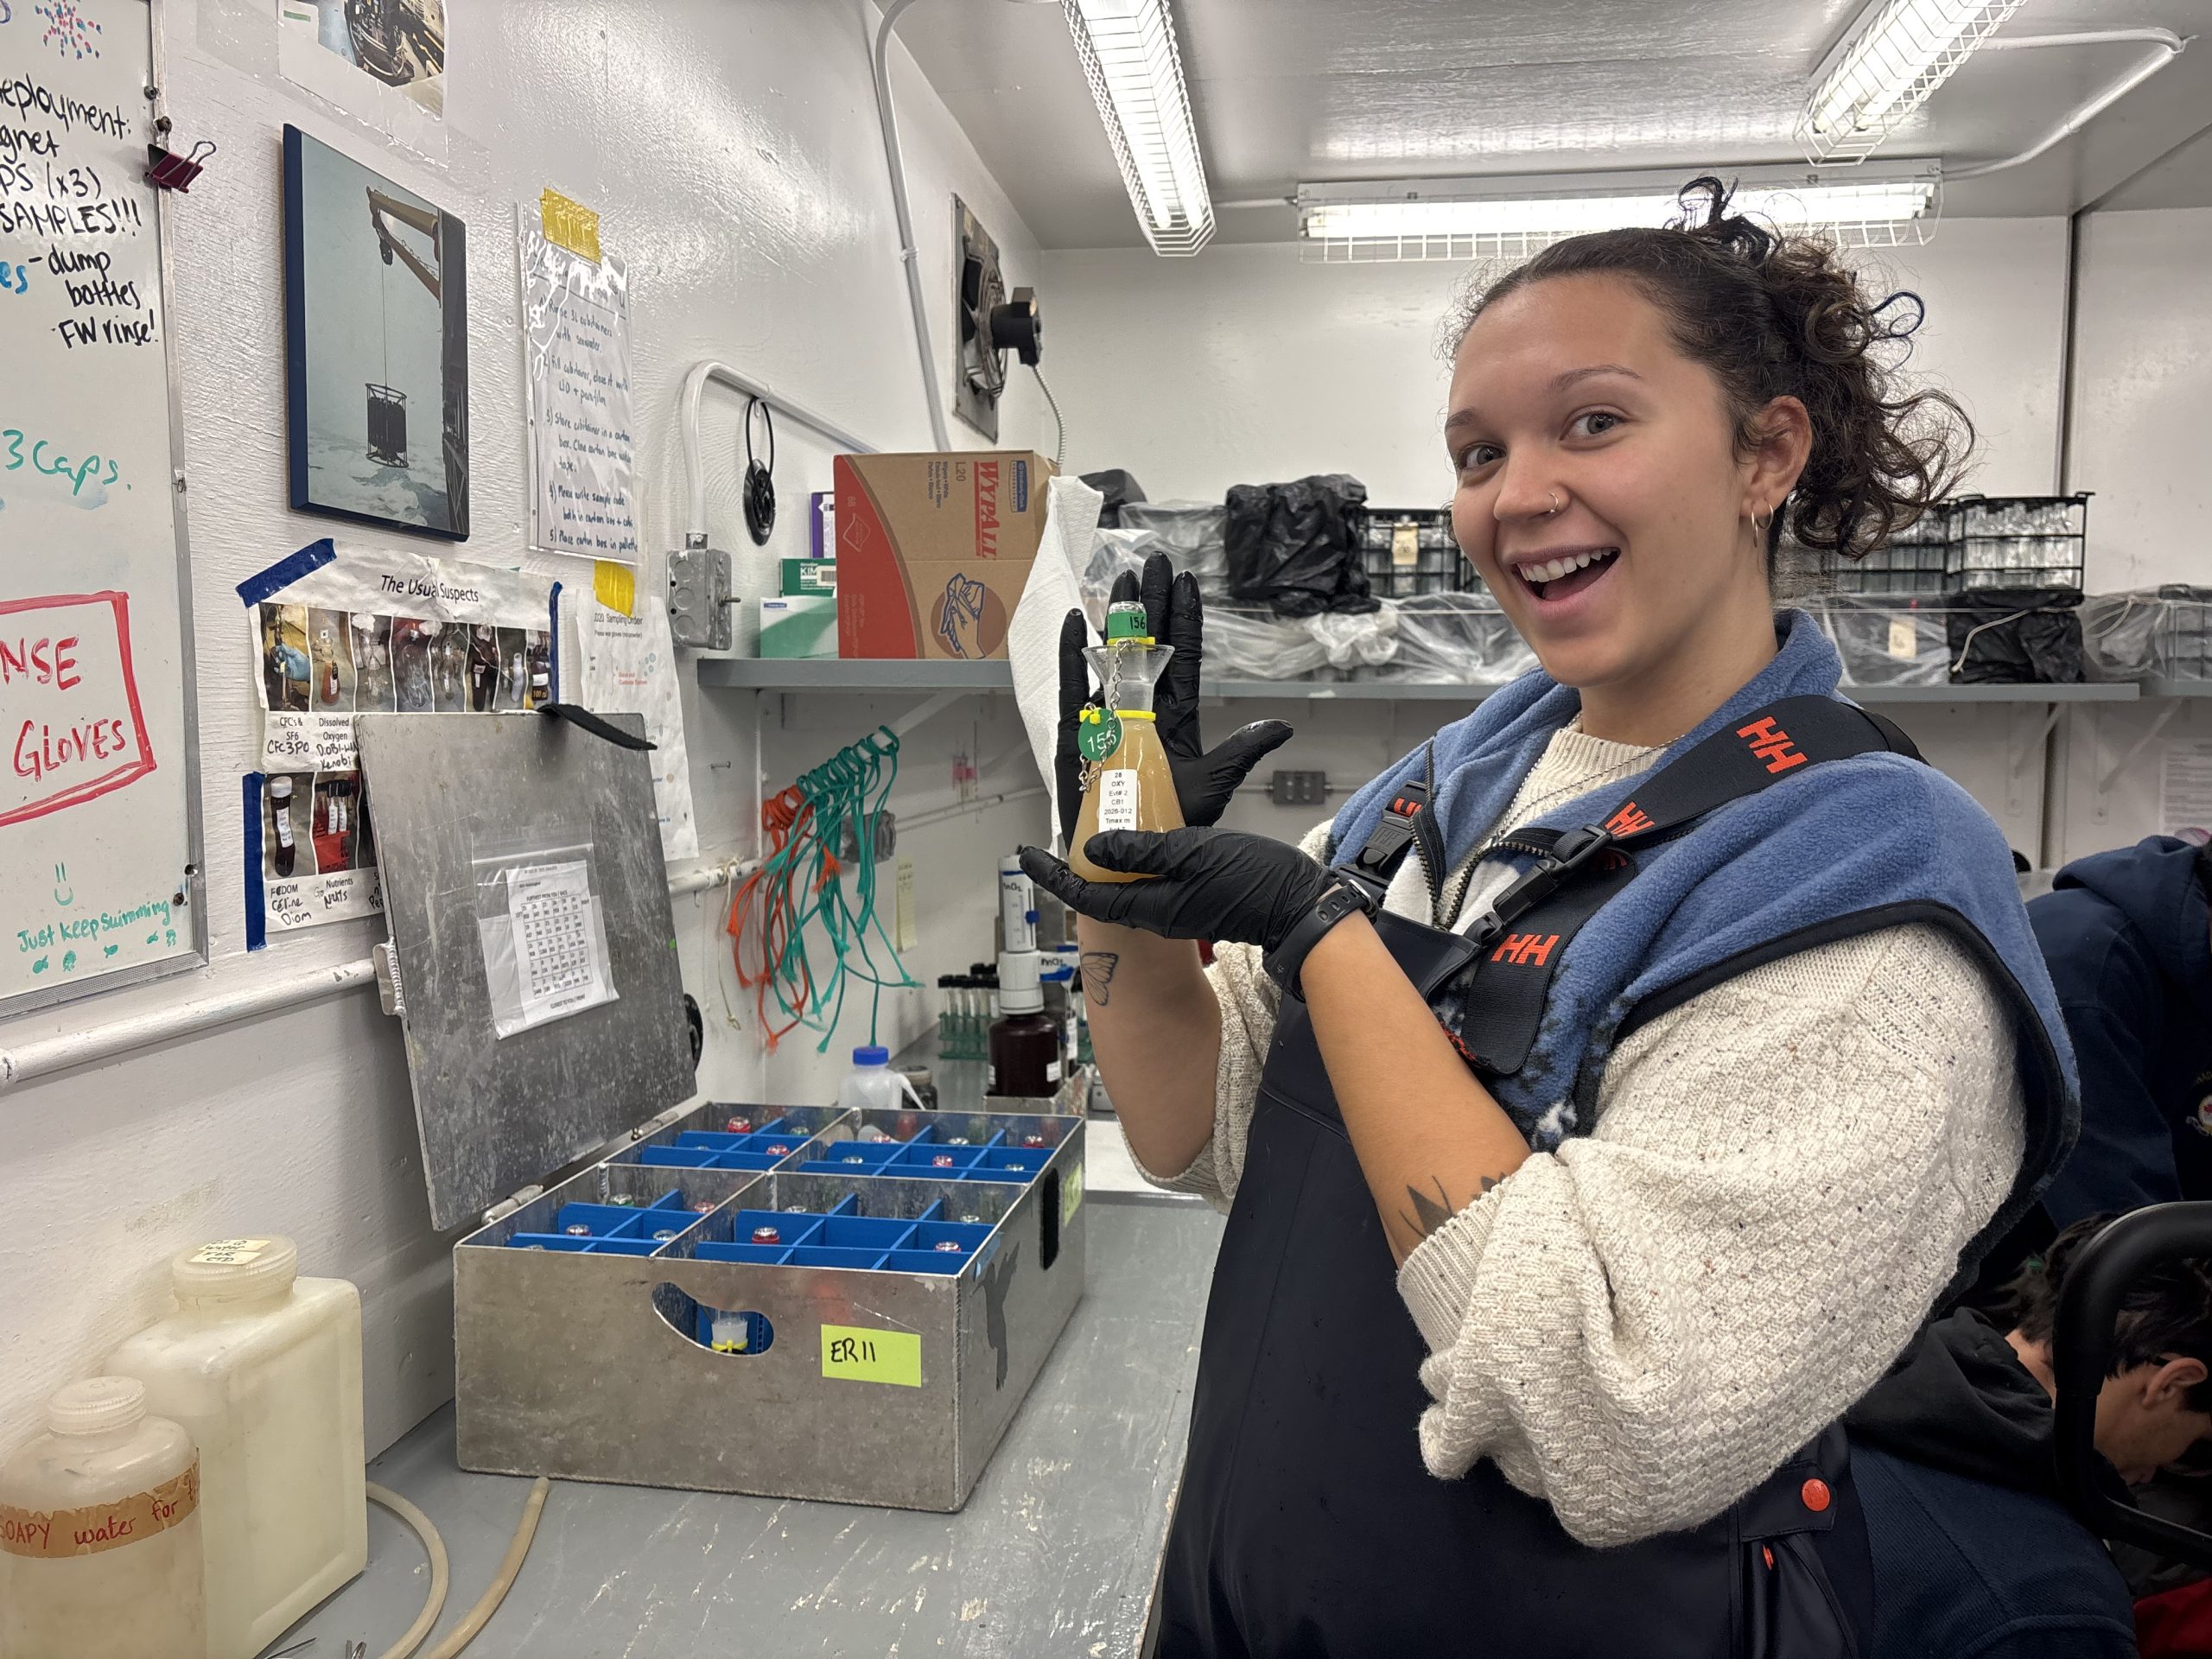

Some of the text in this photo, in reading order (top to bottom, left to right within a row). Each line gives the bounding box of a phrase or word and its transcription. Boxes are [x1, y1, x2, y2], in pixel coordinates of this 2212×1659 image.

[0, 73, 131, 140] eployment:
[65, 279, 141, 310] bottles
[58, 308, 159, 349] FW rinse!
[546, 405, 553, 427] 3)
[956, 461, 966, 482] L20
[381, 575, 479, 604] The Usual Suspects
[606, 613, 627, 626] Sampling
[1129, 616, 1147, 630] 156
[279, 717, 303, 727] CFC's &
[318, 717, 350, 727] Dissolved
[286, 731, 299, 741] SF6
[322, 731, 348, 742] Oxygen
[1736, 715, 1808, 774] HH
[1605, 801, 1656, 838] HH
[326, 877, 354, 889] Nutrients
[17, 924, 55, 952] Just
[1491, 933, 1560, 967] HH
[73, 1516, 137, 1545] water
[151, 1499, 179, 1522] for
